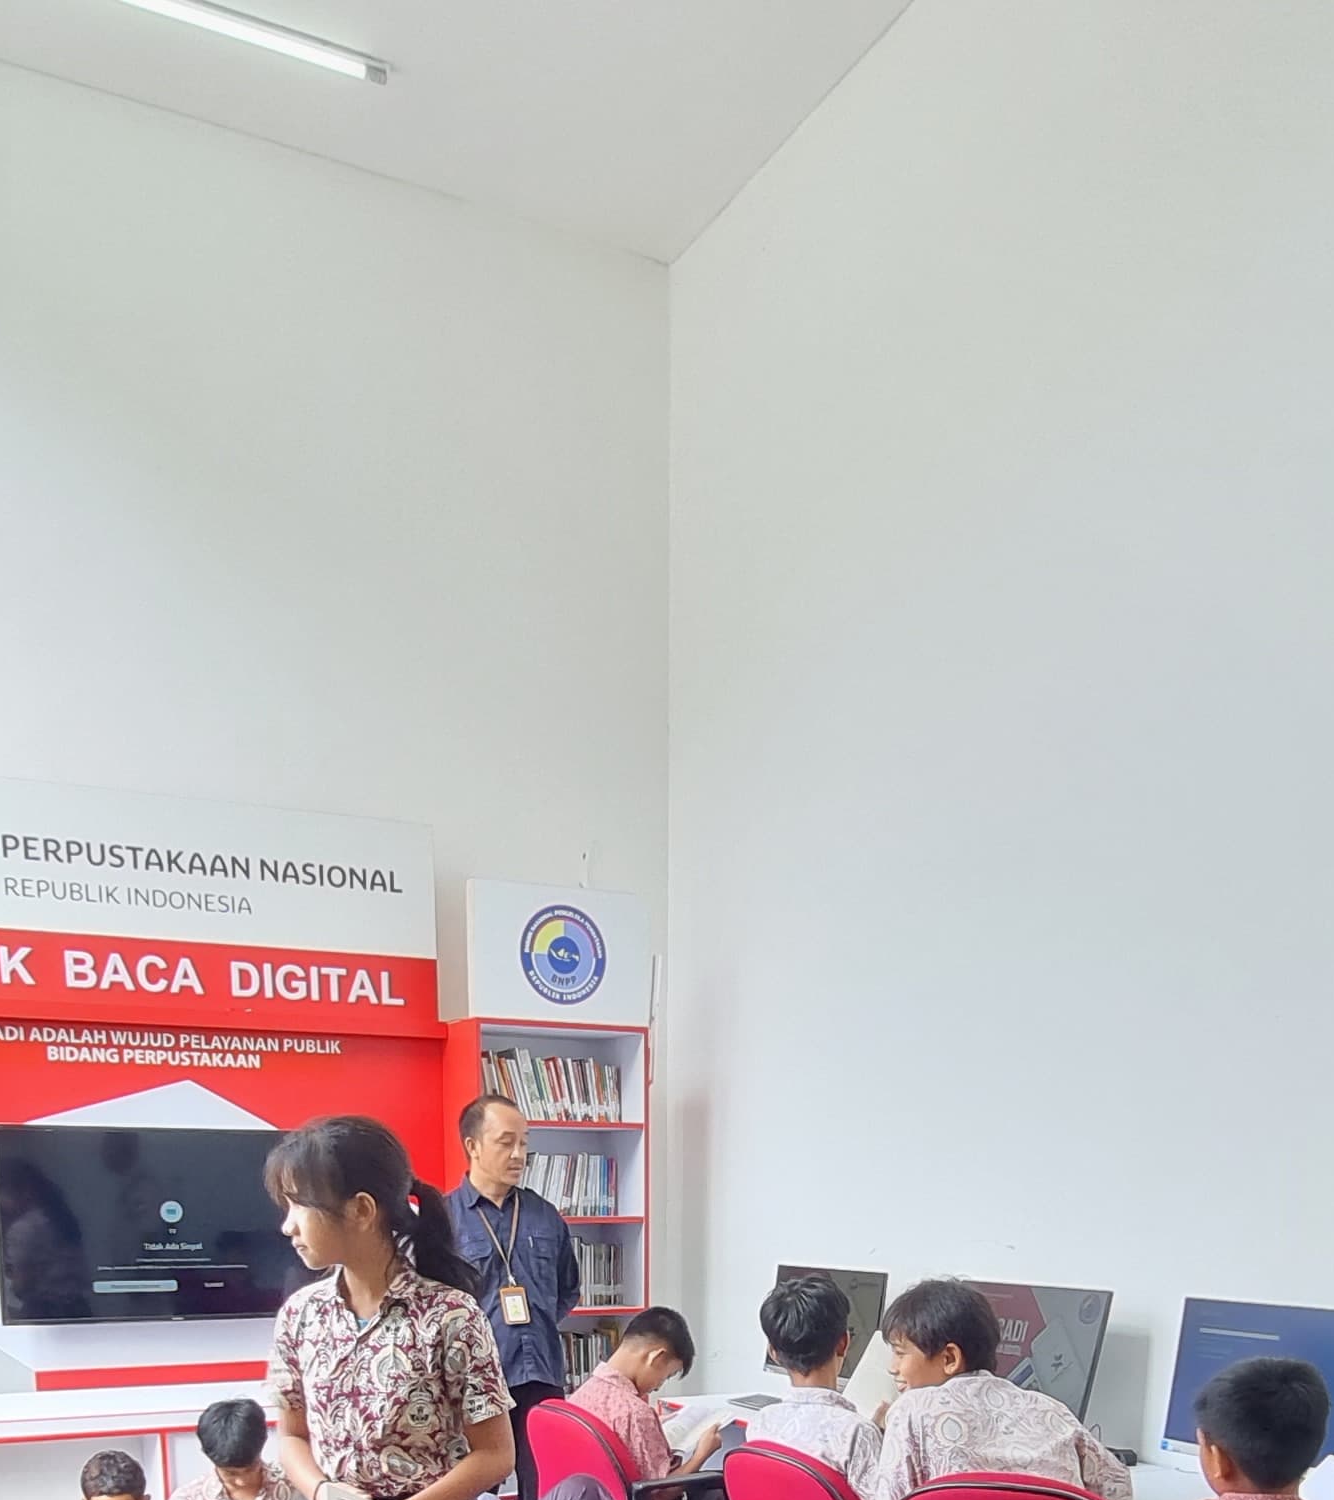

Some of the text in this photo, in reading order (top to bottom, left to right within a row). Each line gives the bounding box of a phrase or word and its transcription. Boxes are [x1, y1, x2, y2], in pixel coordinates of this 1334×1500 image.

[1, 834, 403, 894] PERPUSTAKAAN NASIONAL
[4, 877, 252, 915] REPUBLIK INDONESIA
[64, 949, 204, 996] BACA
[230, 960, 406, 1006] DIGITAL
[29, 1027, 107, 1046] ADALAH
[110, 1030, 175, 1048] WUJUD
[179, 1034, 280, 1052] PELAYANAN
[283, 1038, 341, 1055] PUBLIK
[47, 1045, 261, 1069] BIDANG PERPUSTAKAAN
